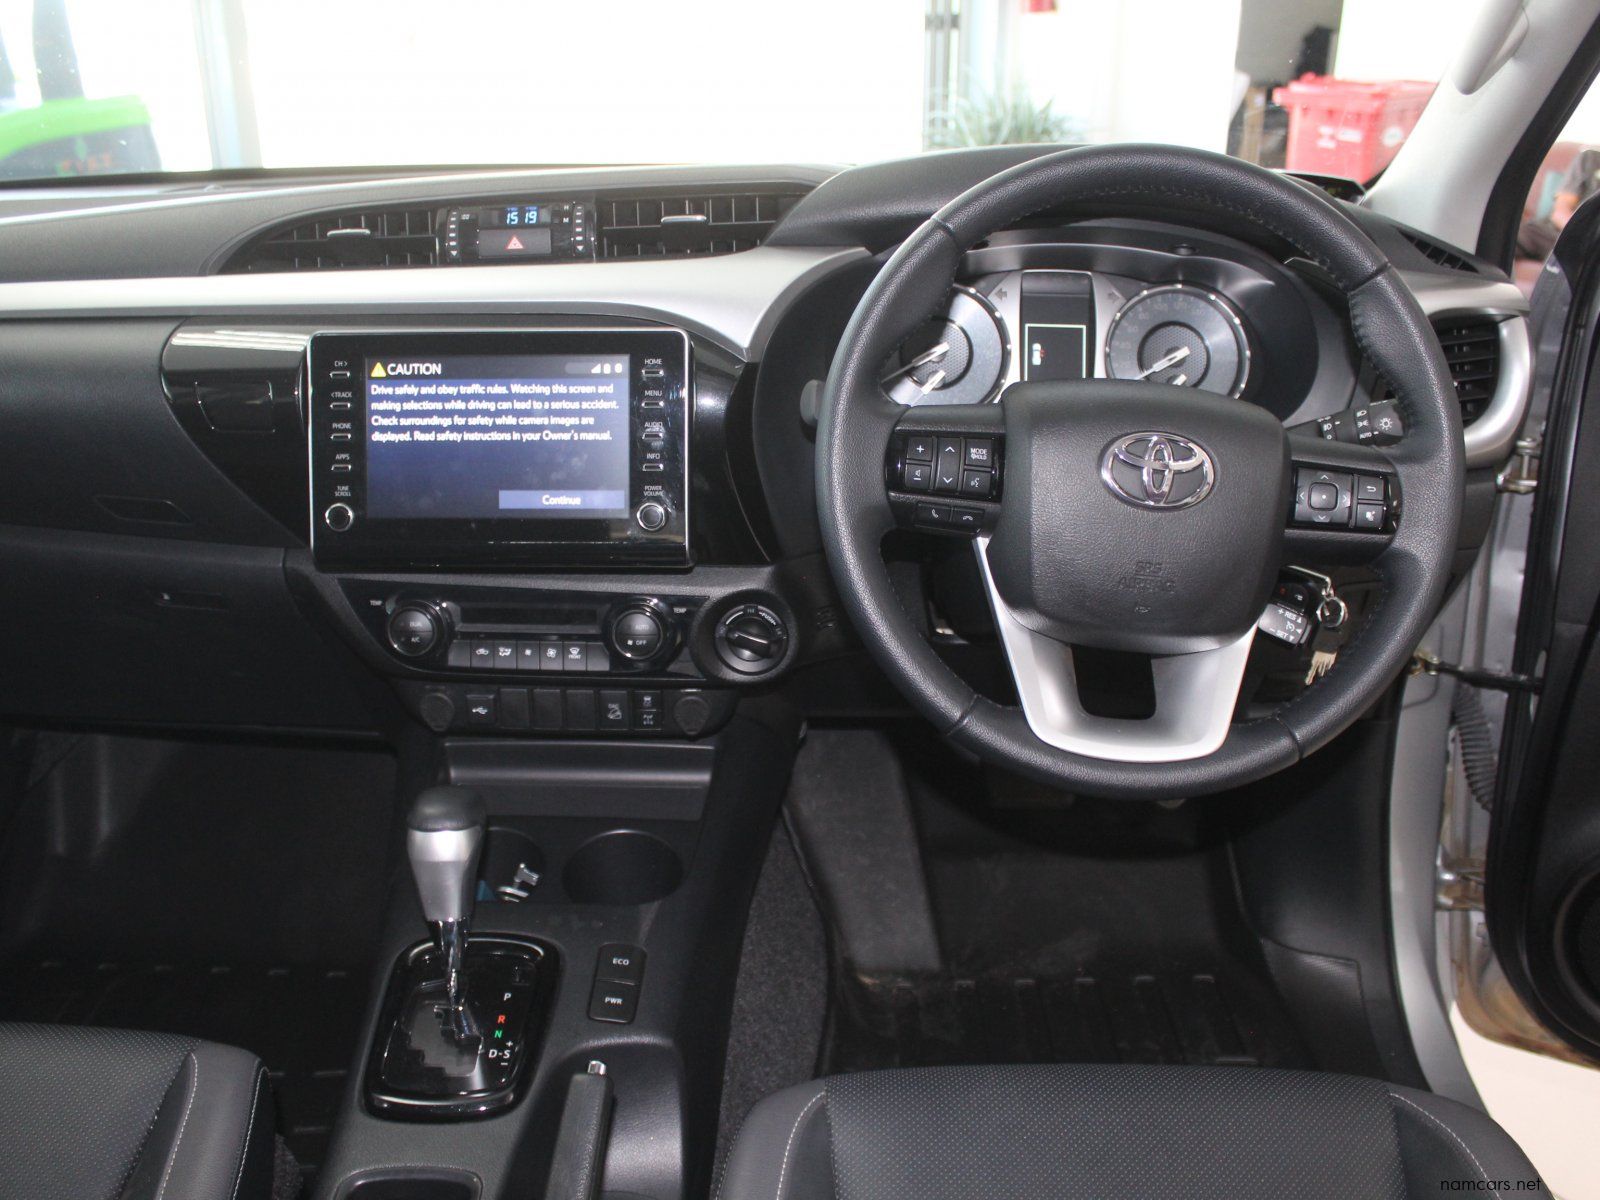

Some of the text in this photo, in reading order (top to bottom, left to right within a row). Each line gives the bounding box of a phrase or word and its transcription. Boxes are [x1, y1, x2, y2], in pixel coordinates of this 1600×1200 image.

[387, 363, 442, 375] CAUTION
[371, 383, 614, 396] Drive safely and obey traffic rules. Watching this screen and
[371, 400, 401, 412] making
[402, 400, 443, 410] selections
[444, 400, 466, 410] while
[467, 400, 496, 411] driving
[497, 402, 512, 410] can
[513, 400, 532, 410] lead
[532, 401, 542, 410] to
[551, 400, 580, 409] serious
[581, 399, 619, 409] accident.
[371, 415, 594, 427] Check surroundings for safety while camera images are
[371, 430, 612, 443] displayed. Read safety instructions in your Owner's manual.
[542, 494, 581, 505] Continue
[1284, 612, 1297, 621] RES
[1276, 630, 1288, 639] SET
[612, 958, 629, 966] ECO
[504, 993, 512, 1001] P
[605, 997, 623, 1005] PWR
[497, 1015, 506, 1024] R
[494, 1030, 503, 1039] N
